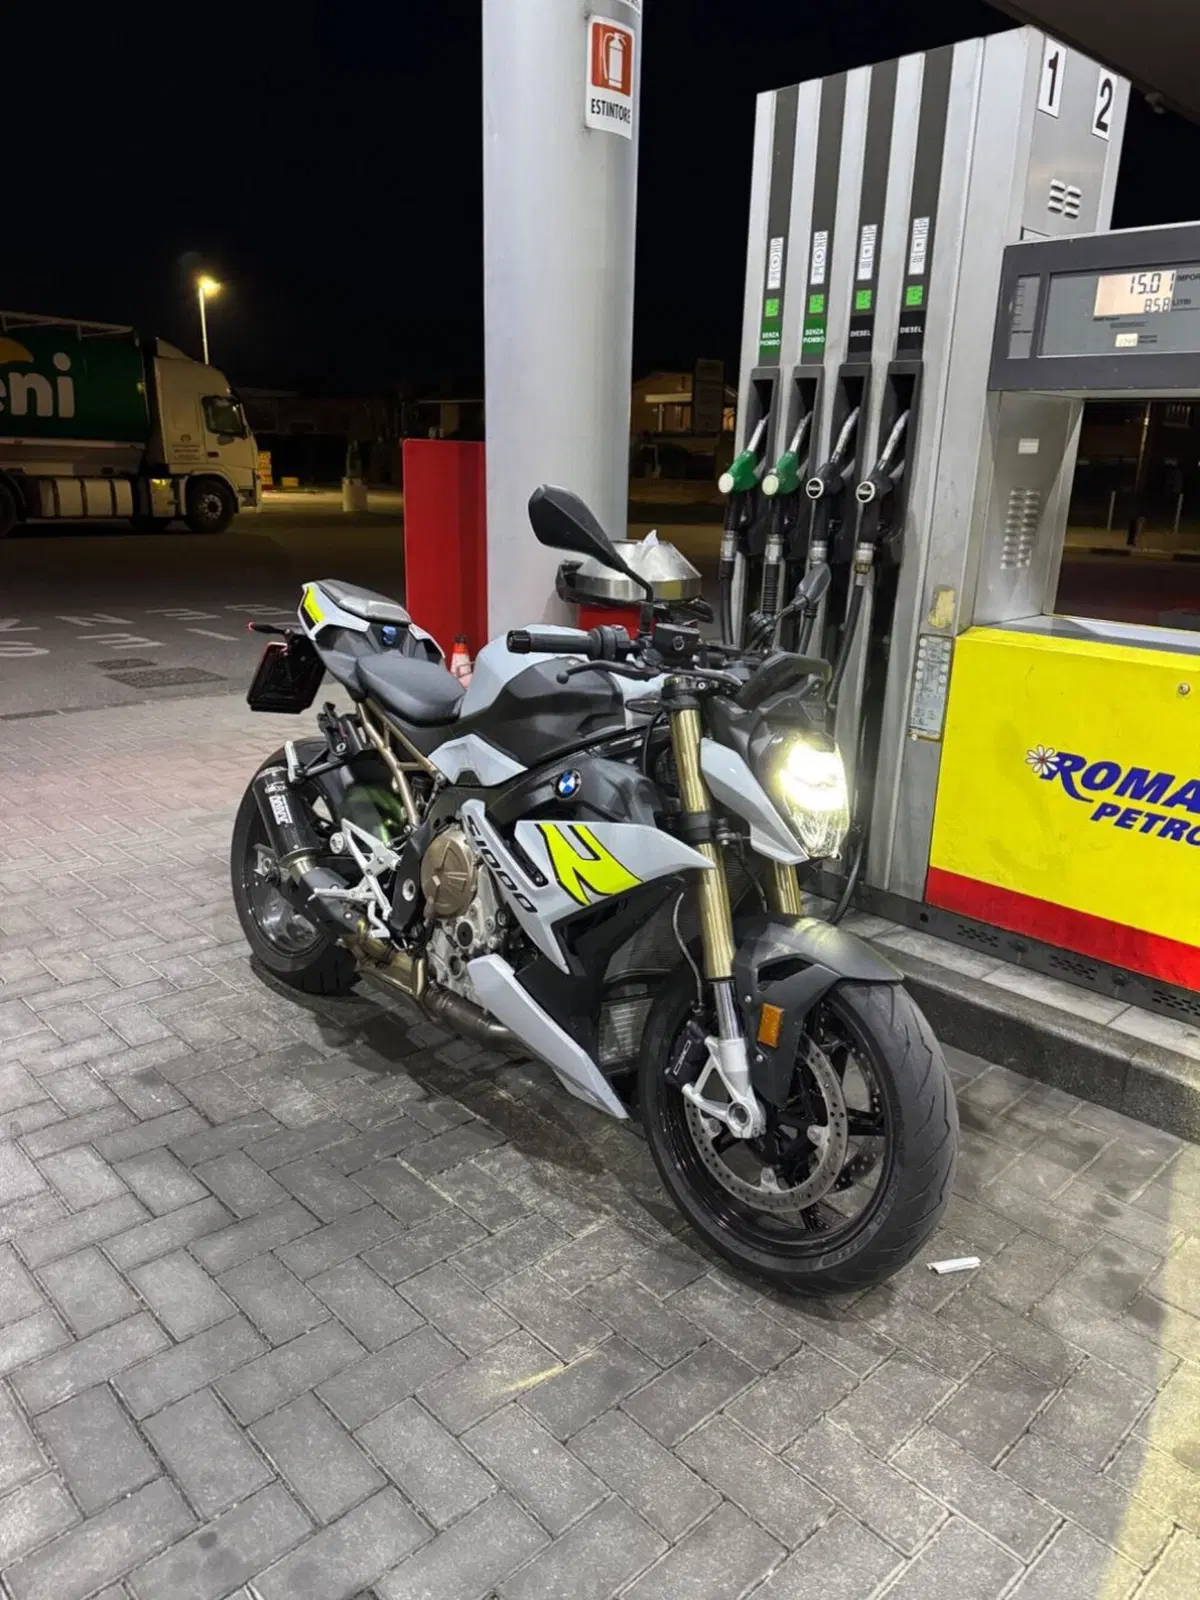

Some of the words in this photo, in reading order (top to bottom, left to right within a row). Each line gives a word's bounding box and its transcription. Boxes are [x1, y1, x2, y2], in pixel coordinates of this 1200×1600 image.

[1048, 50, 1059, 107] 1
[1095, 78, 1113, 133] 2
[591, 98, 631, 124] ESTINTORE
[899, 326, 923, 334] DIESEL
[0, 352, 75, 418] ni
[1040, 752, 1200, 814] ROMA
